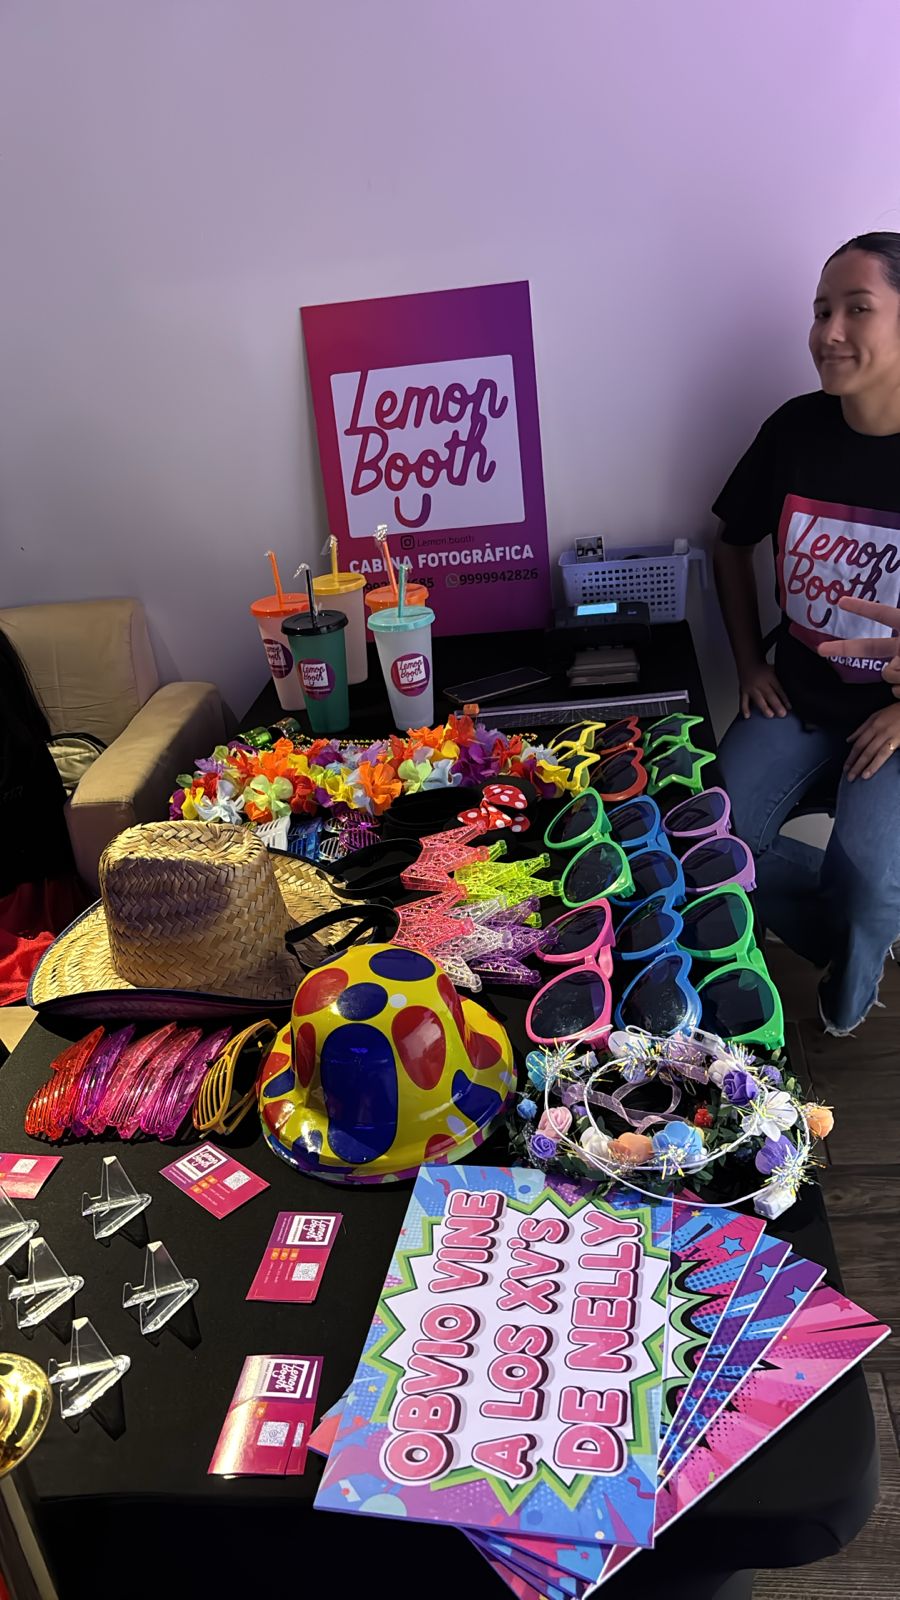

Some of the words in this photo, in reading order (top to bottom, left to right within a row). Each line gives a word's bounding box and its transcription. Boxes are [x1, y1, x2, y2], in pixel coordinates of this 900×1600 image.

[345, 370, 508, 435] Lemon
[350, 413, 496, 495] Booth
[459, 568, 538, 586] 9999942826
[788, 516, 900, 574] Lemon
[788, 552, 879, 605] Booth
[429, 1191, 504, 1293] VINE
[497, 1217, 570, 1314] XV'S
[565, 1210, 643, 1373] NELLY
[384, 1303, 481, 1481] OBVIO
[479, 1324, 554, 1421] LOS
[472, 1434, 537, 1479] A
[553, 1386, 628, 1472] DE
